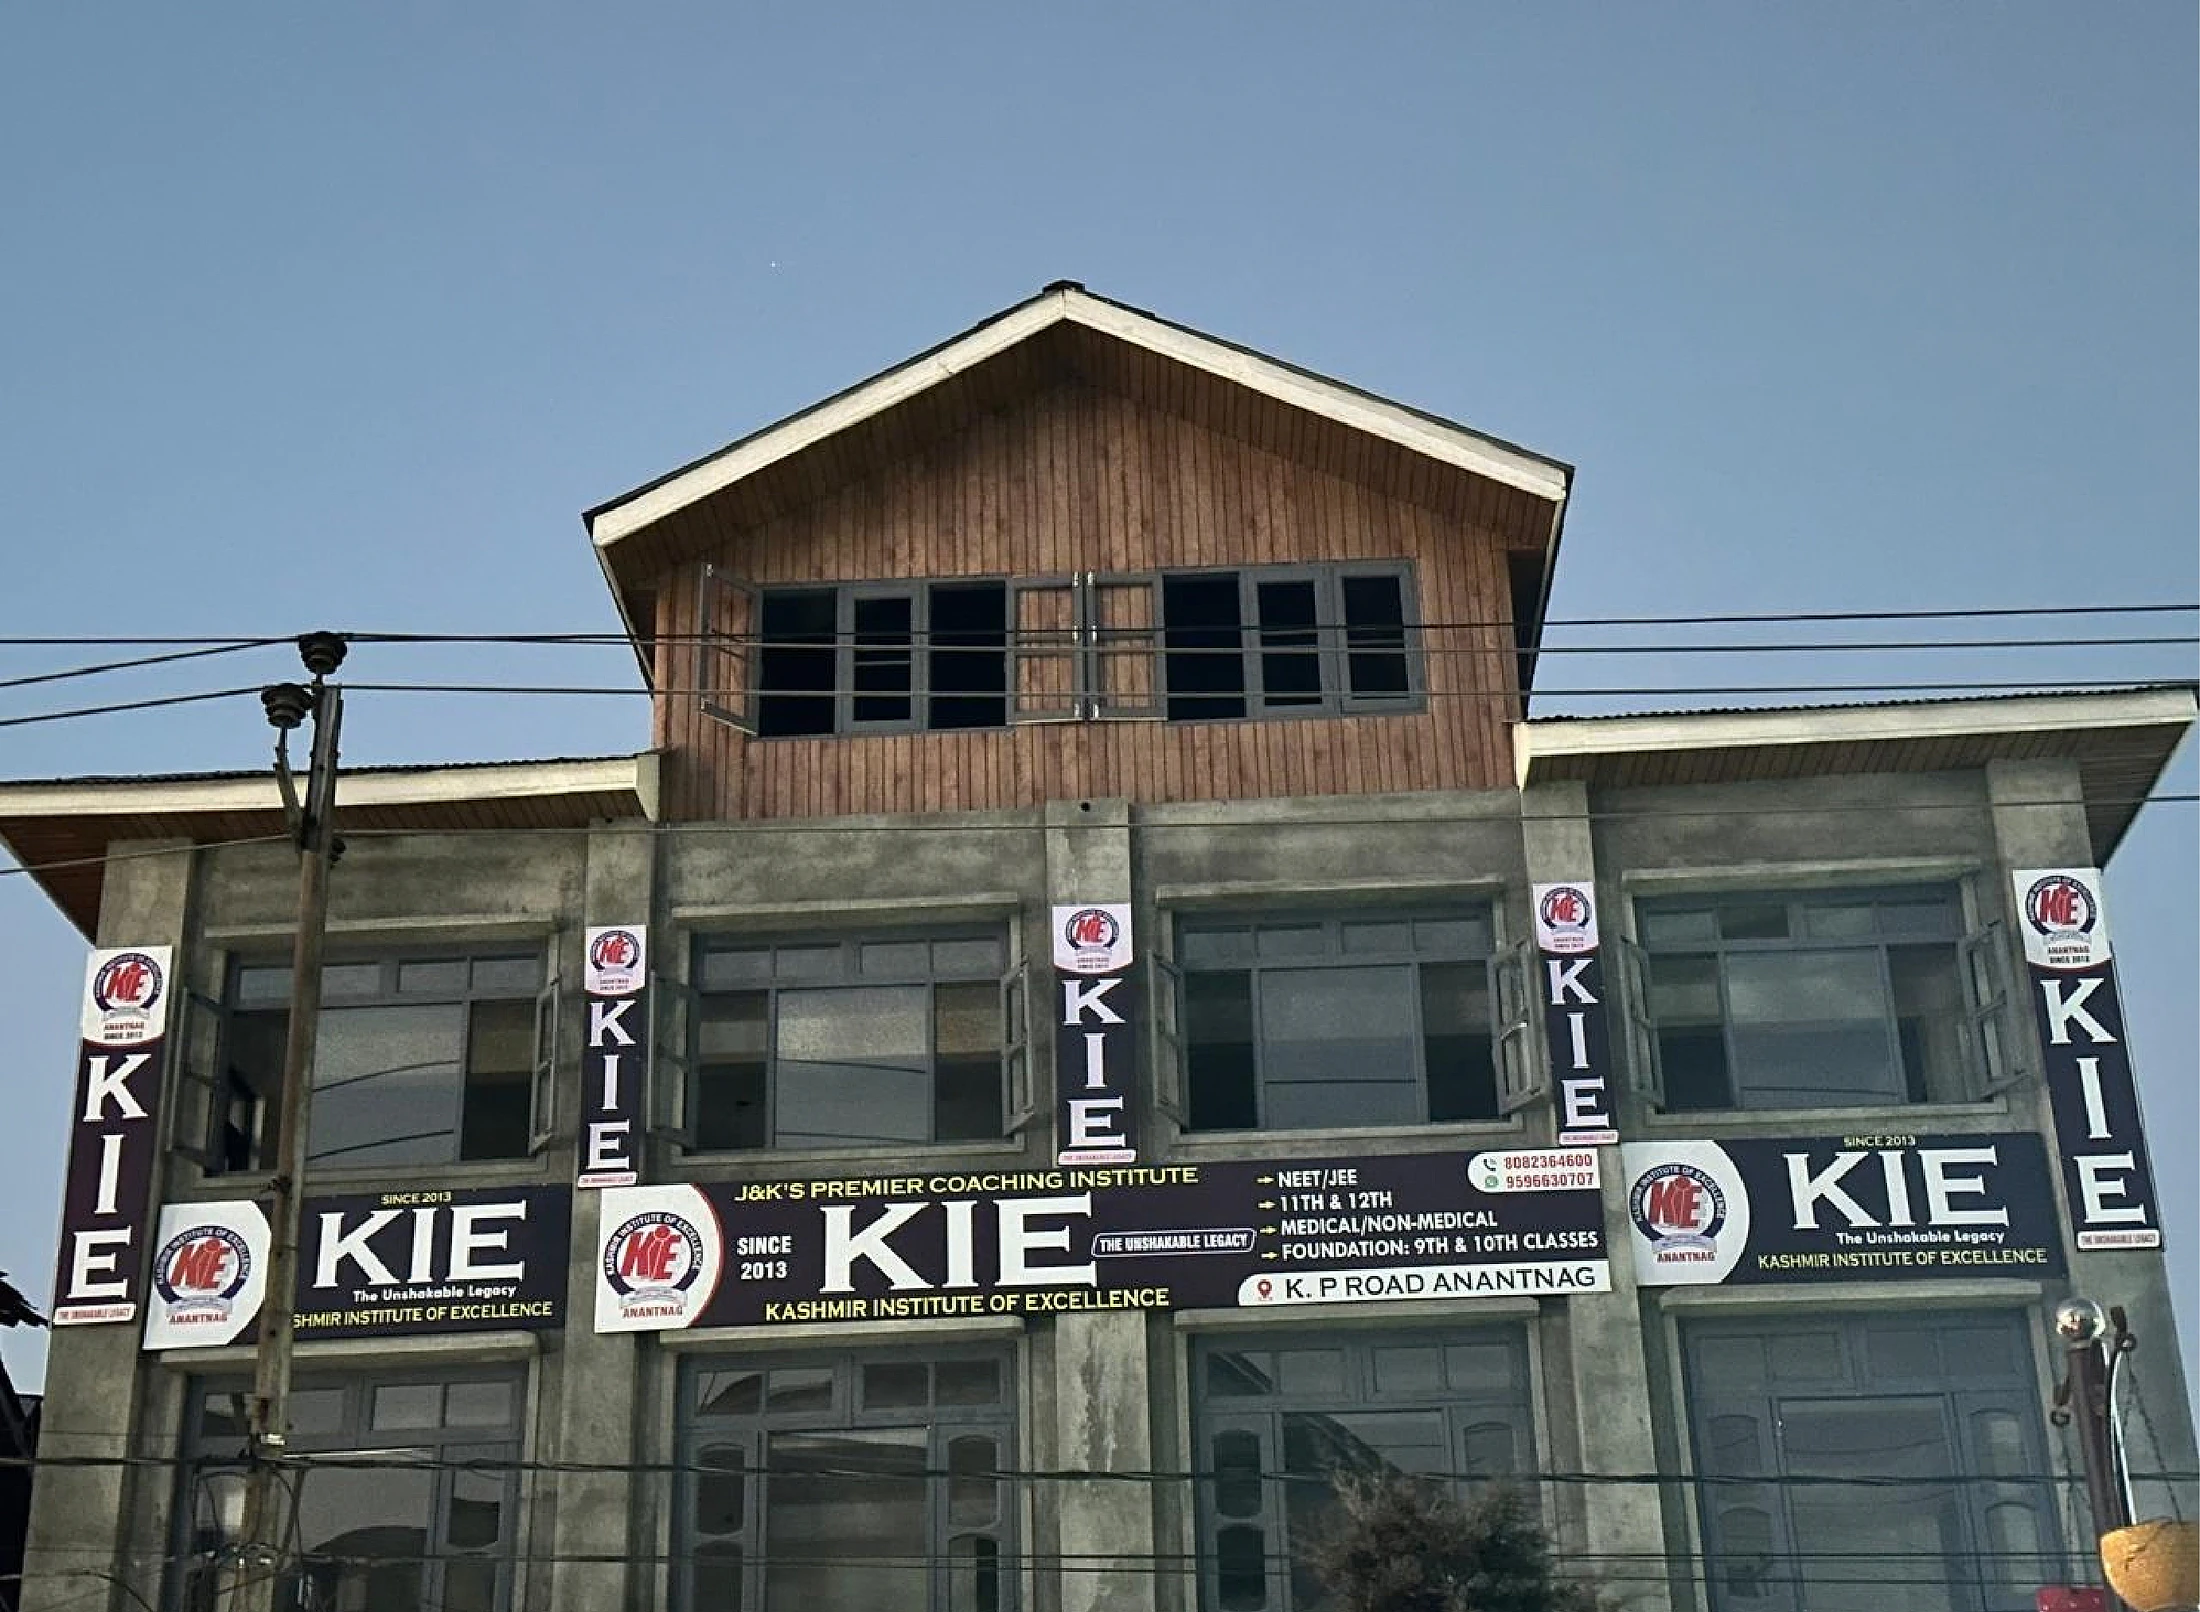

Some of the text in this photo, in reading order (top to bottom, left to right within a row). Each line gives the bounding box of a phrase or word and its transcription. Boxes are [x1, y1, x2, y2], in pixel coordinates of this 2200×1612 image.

[1546, 959, 1609, 1128] KIE
[1062, 978, 1127, 1148] KIE
[586, 1000, 636, 1169] KIE
[2040, 978, 2148, 1225] KIE
[1843, 1135, 1916, 1147] SINCE 2013
[1504, 1153, 1593, 1169] 8082364600
[66, 1053, 151, 1299] KIE
[734, 1167, 1199, 1201] J&K'S PREMIER COACHING INSTITUTE
[1277, 1169, 1358, 1190] NEET/JEE
[1505, 1172, 1594, 1188] 9596630707
[1782, 1145, 2009, 1230] KIE
[381, 1191, 452, 1205] SINCE 2013
[1280, 1191, 1393, 1211] 11TH & 12TH
[1281, 1210, 1498, 1236] MEDICAL/NON-MEDICAL
[312, 1200, 527, 1289] KIE
[736, 1234, 792, 1256] SINCE
[819, 1191, 1098, 1294] KIE
[1100, 1233, 1248, 1252] THE UNSHAKABLE LEGACY
[1282, 1231, 1599, 1261] FOUNDATION: 9TH & 10TH CLASSES
[1836, 1230, 2005, 1244] The Unshakable Legacy
[740, 1260, 788, 1280] 2013
[1758, 1248, 2048, 1269] KASHMIR INSTITUTE OF EXCELLENCE
[353, 1286, 517, 1302] The Unshakable Legacy
[1286, 1266, 1596, 1299] K. P ROAD ANANTNAG
[293, 1301, 553, 1329] SHMIR INSTITUTE OF EXCELLENCE
[623, 1305, 683, 1318] ANANTNAG
[766, 1288, 1170, 1321] KASHMIR INSTITUTE OF EXCELLENCE
